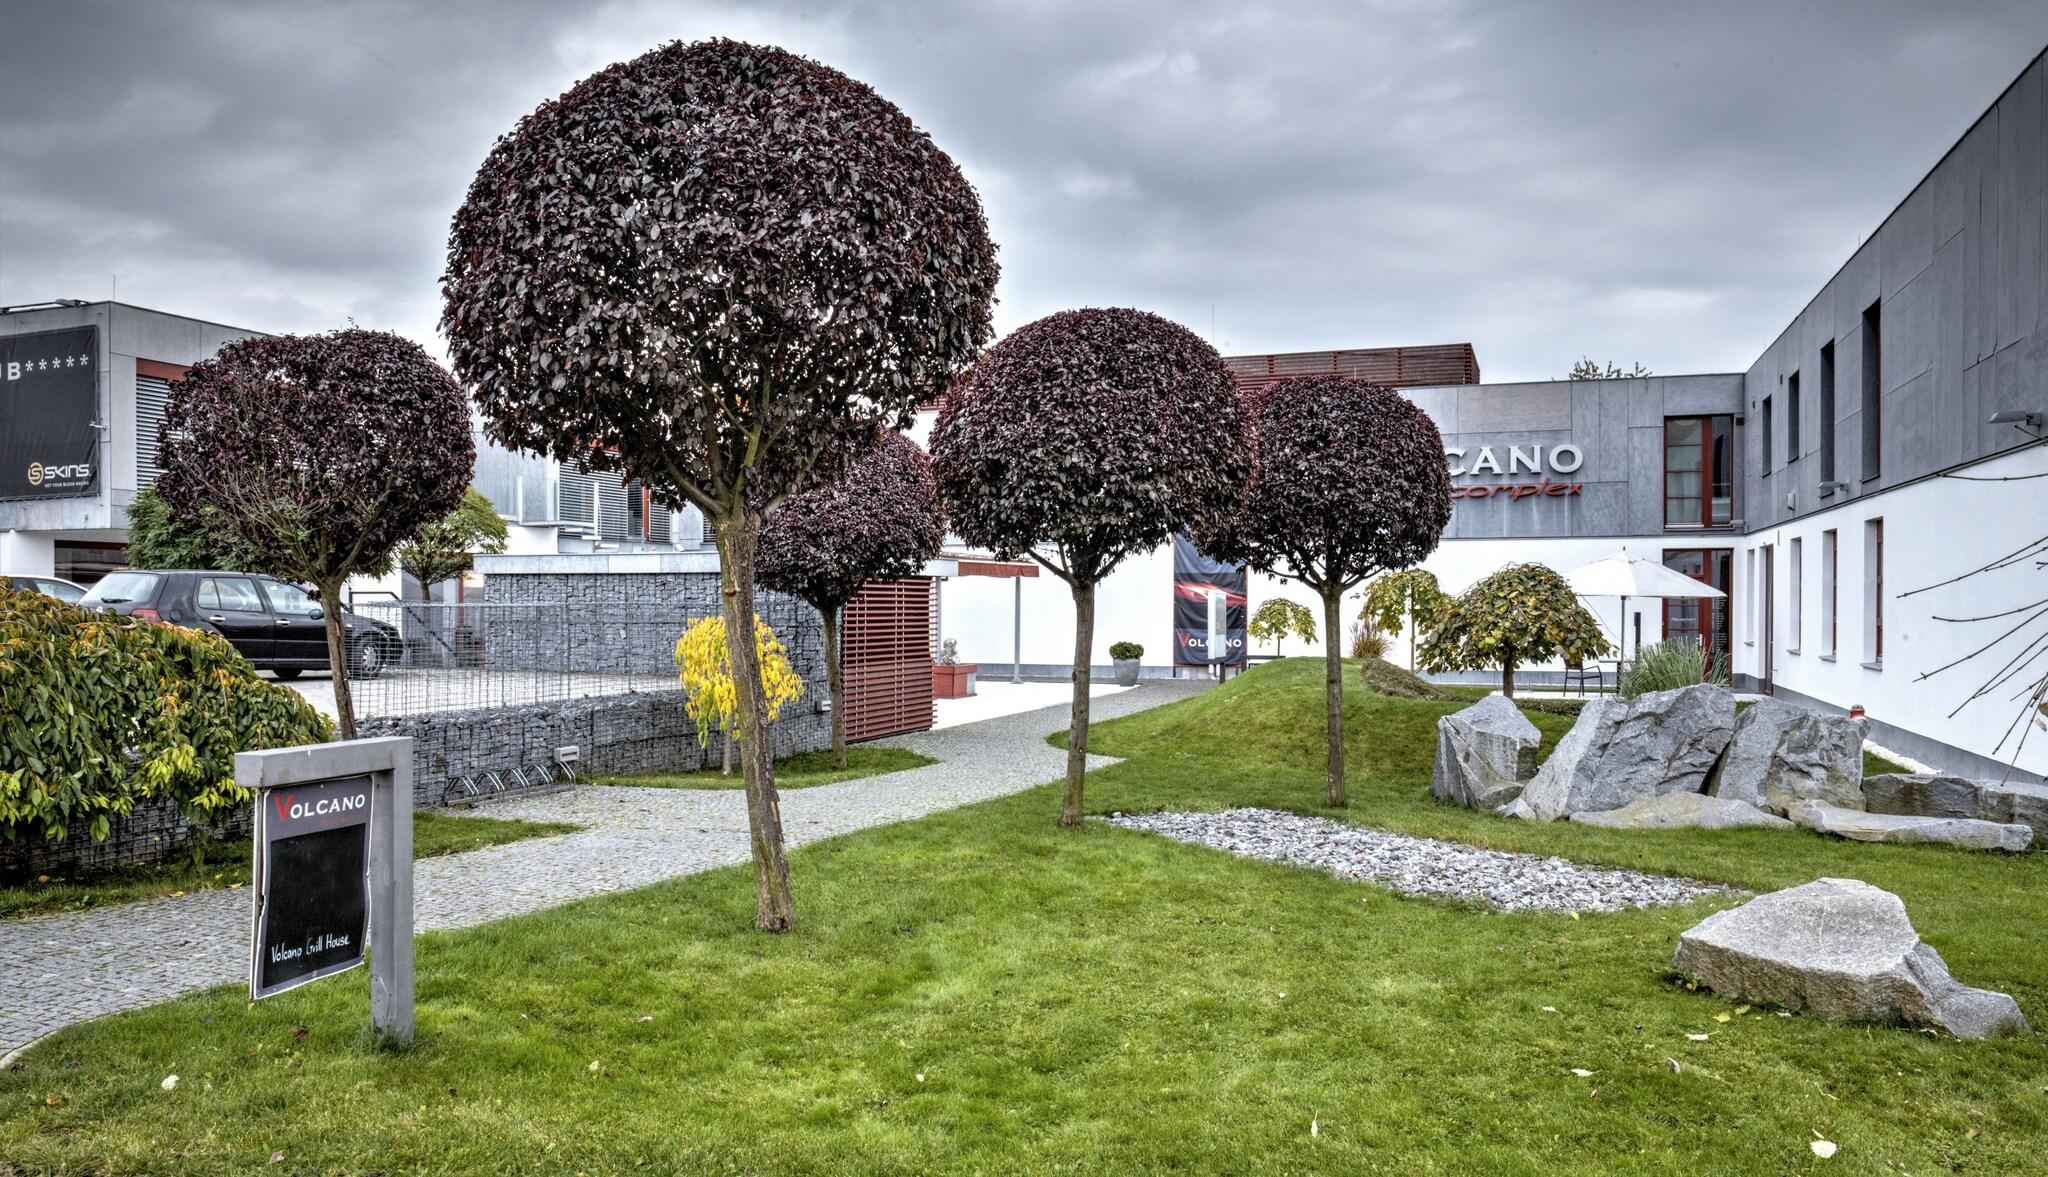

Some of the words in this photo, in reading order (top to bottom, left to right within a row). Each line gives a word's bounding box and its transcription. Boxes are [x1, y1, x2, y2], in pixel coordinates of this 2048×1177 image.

[1451, 477, 1583, 502] complex
[1175, 632, 1242, 648] VOLNO
[274, 794, 366, 822] VOLCANO
[271, 942, 303, 963] Volcano
[305, 935, 323, 955] Grill
[325, 933, 350, 950] House
